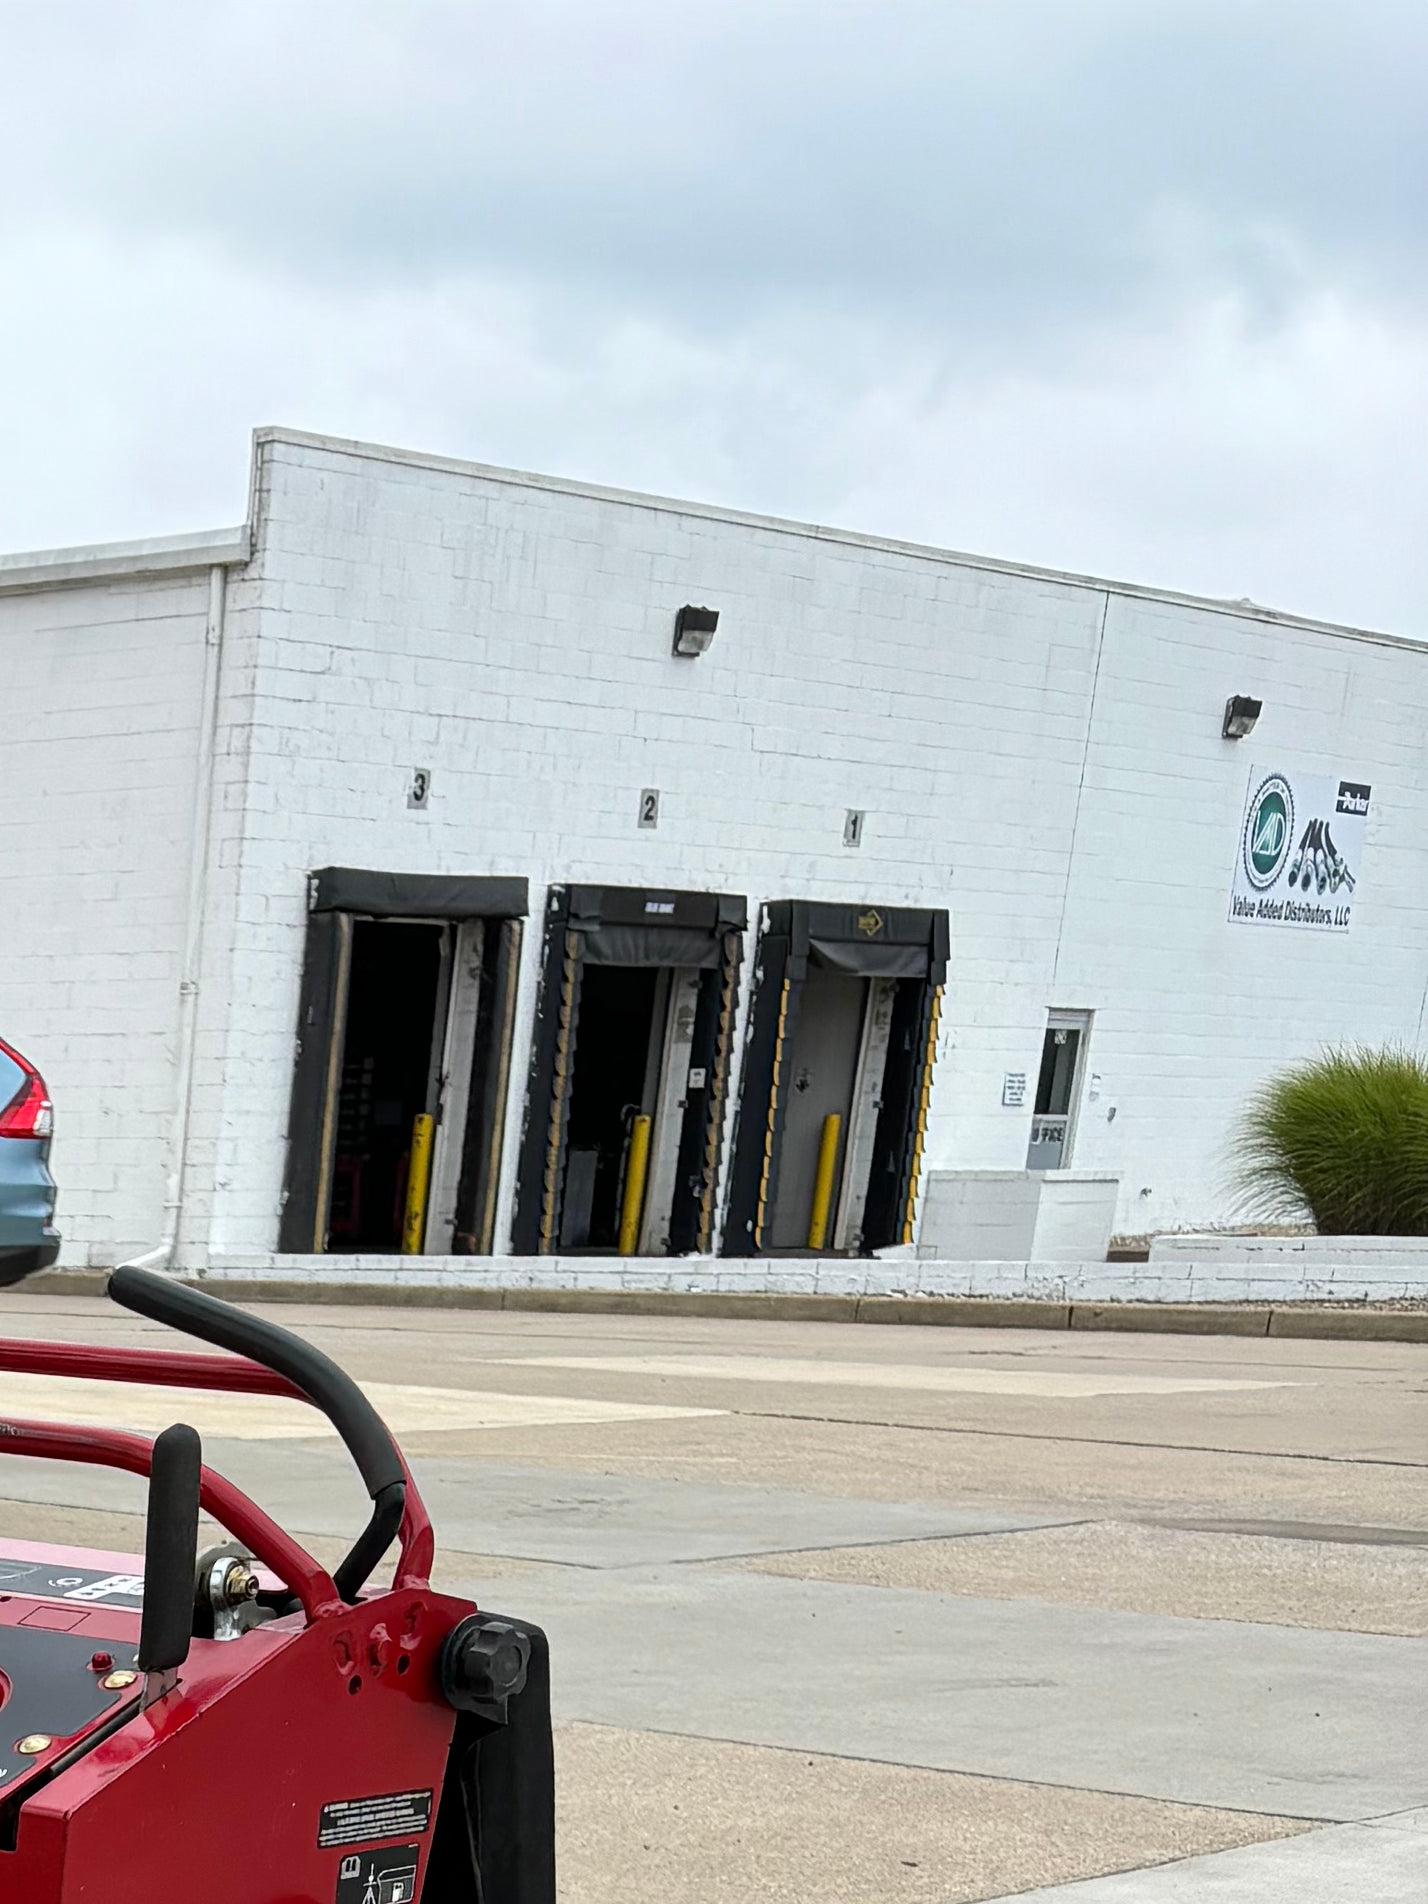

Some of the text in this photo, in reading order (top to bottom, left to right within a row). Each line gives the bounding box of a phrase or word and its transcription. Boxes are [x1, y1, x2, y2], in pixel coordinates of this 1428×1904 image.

[1232, 896, 1255, 917] Value
[1256, 899, 1282, 921] Added
[1334, 906, 1350, 926] LLC
